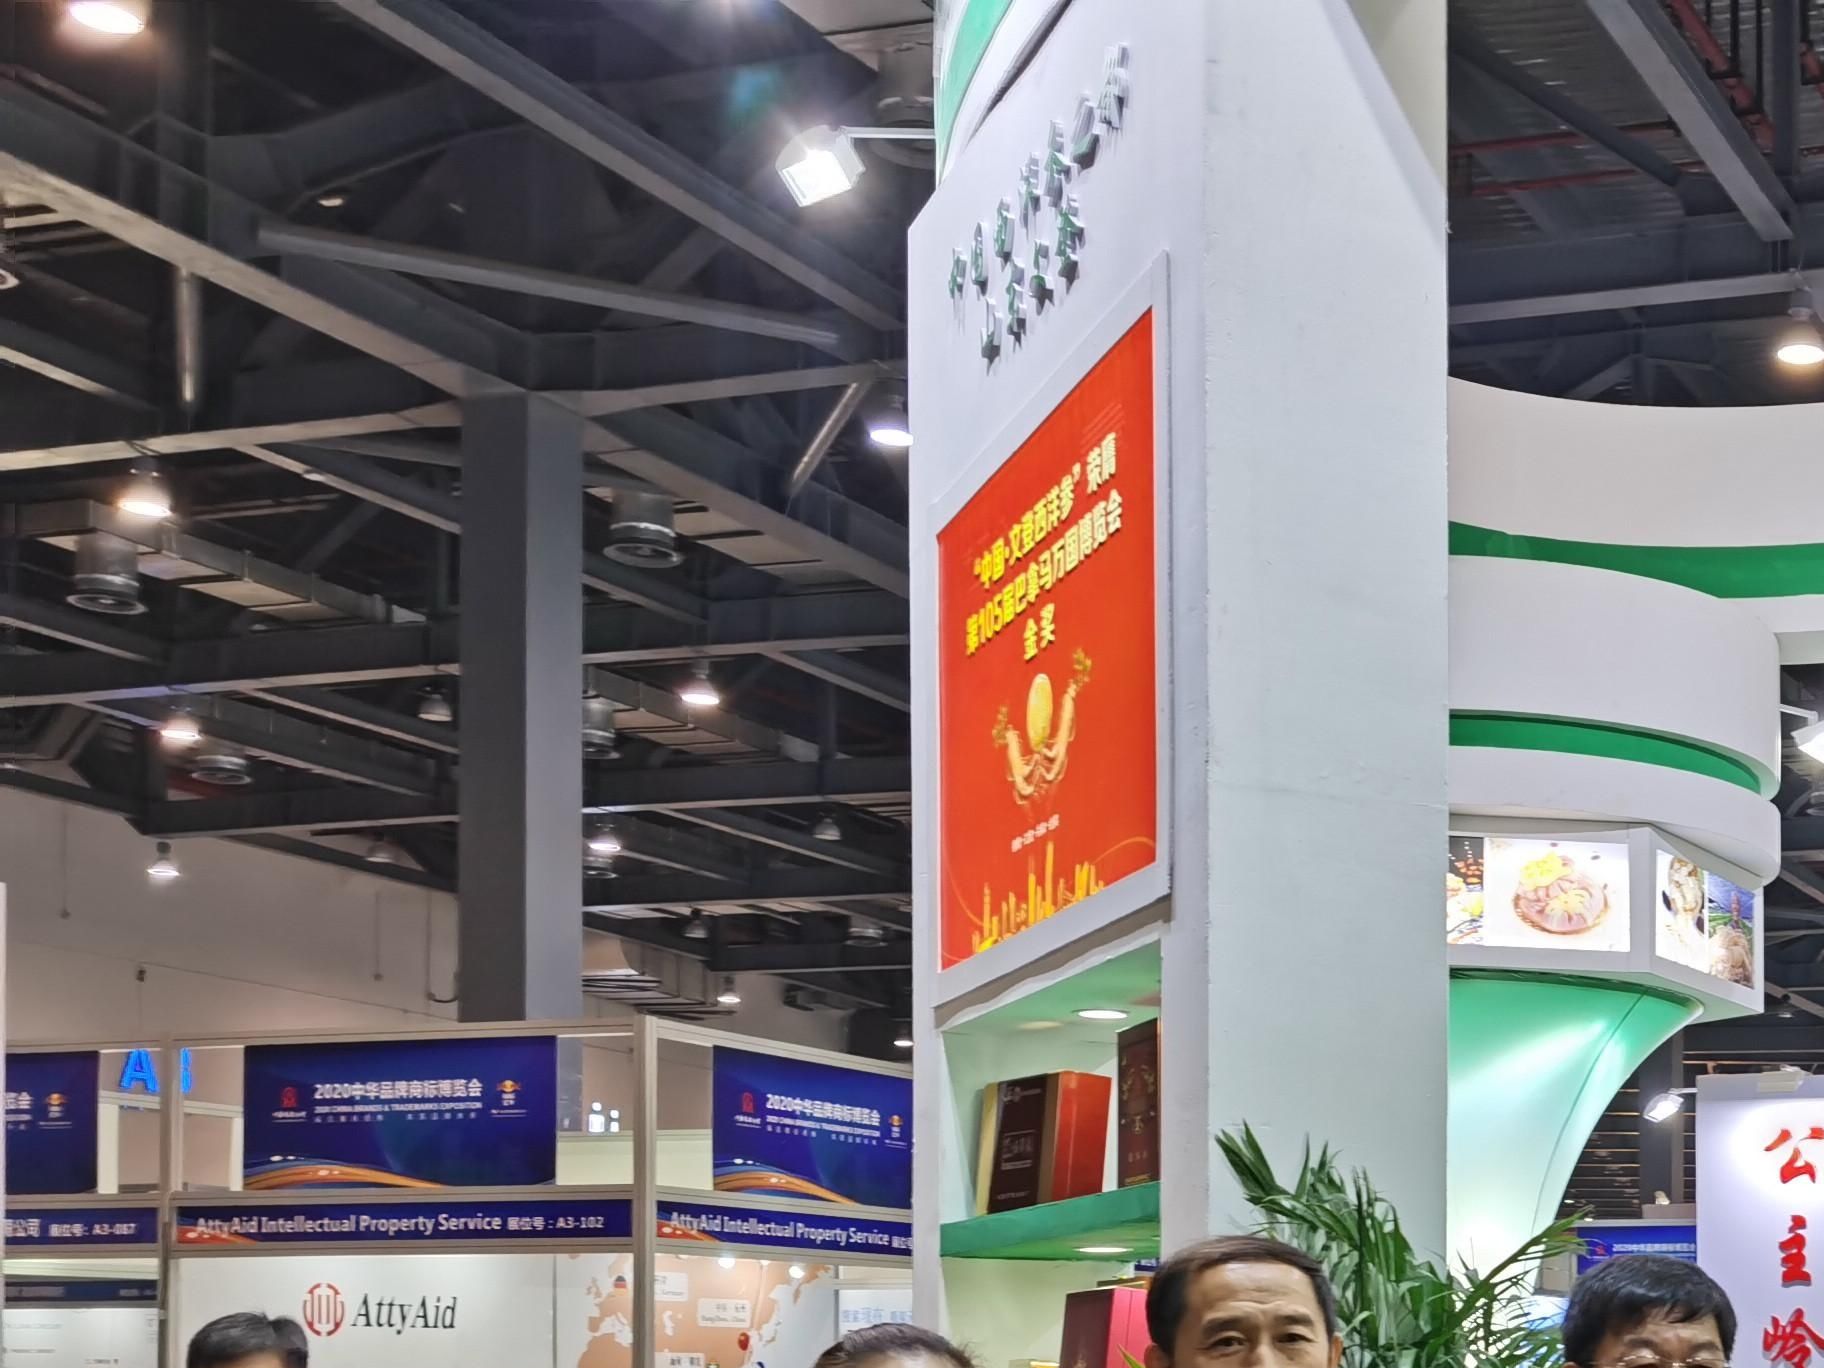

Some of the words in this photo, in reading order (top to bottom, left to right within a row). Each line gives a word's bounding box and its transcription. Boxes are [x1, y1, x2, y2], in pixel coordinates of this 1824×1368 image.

[965, 488, 1123, 656] 第105届巴拿马万国博览会
[1023, 602, 1056, 661] 金奖
[313, 1077, 483, 1100] 2020中华品牌商标博览会
[197, 1216, 259, 1236] AttyAid
[261, 1215, 356, 1234] Intellectual
[359, 1214, 435, 1236] Property
[438, 1212, 502, 1231] Service
[670, 1211, 722, 1234] AttyAid
[724, 1216, 795, 1238] Intellectual
[796, 1222, 847, 1246] Property
[849, 1228, 890, 1246] Service
[351, 1293, 458, 1335] AttyAid
